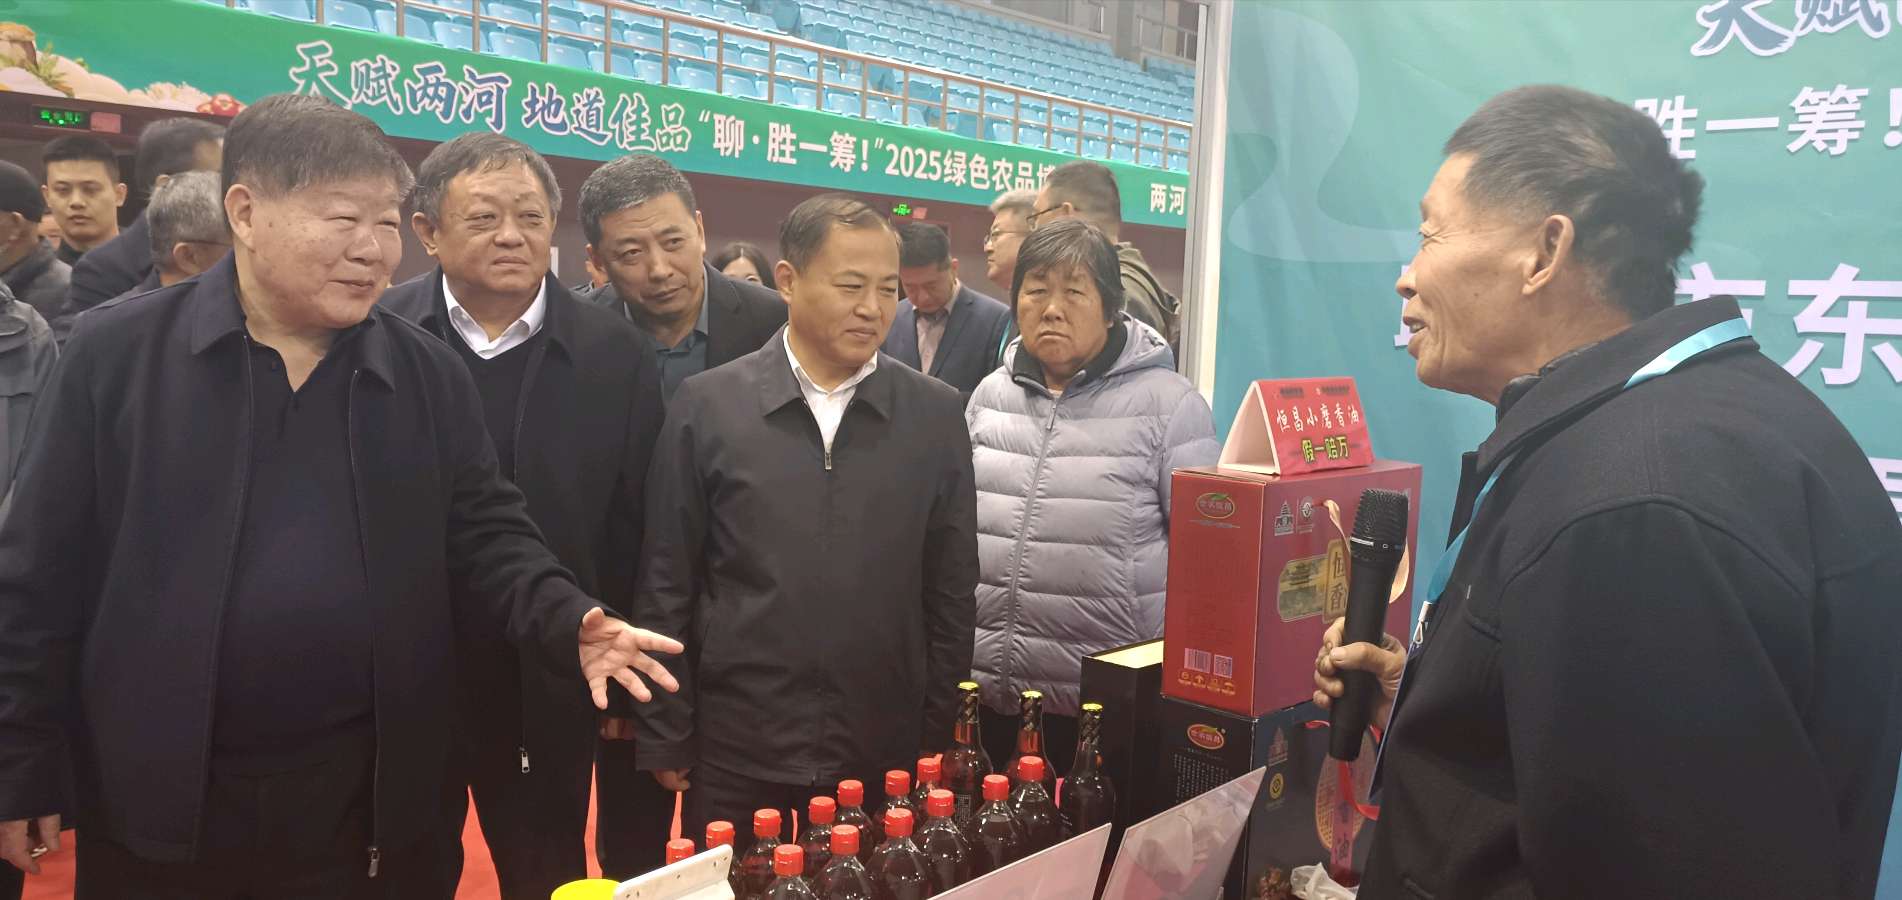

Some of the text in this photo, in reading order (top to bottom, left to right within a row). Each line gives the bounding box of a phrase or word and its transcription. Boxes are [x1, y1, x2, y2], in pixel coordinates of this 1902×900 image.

[289, 40, 512, 133] 天赋两河
[521, 83, 692, 152] 地道佳品
[1149, 183, 1187, 216] 两河
[1302, 436, 1349, 462] 假一赔万
